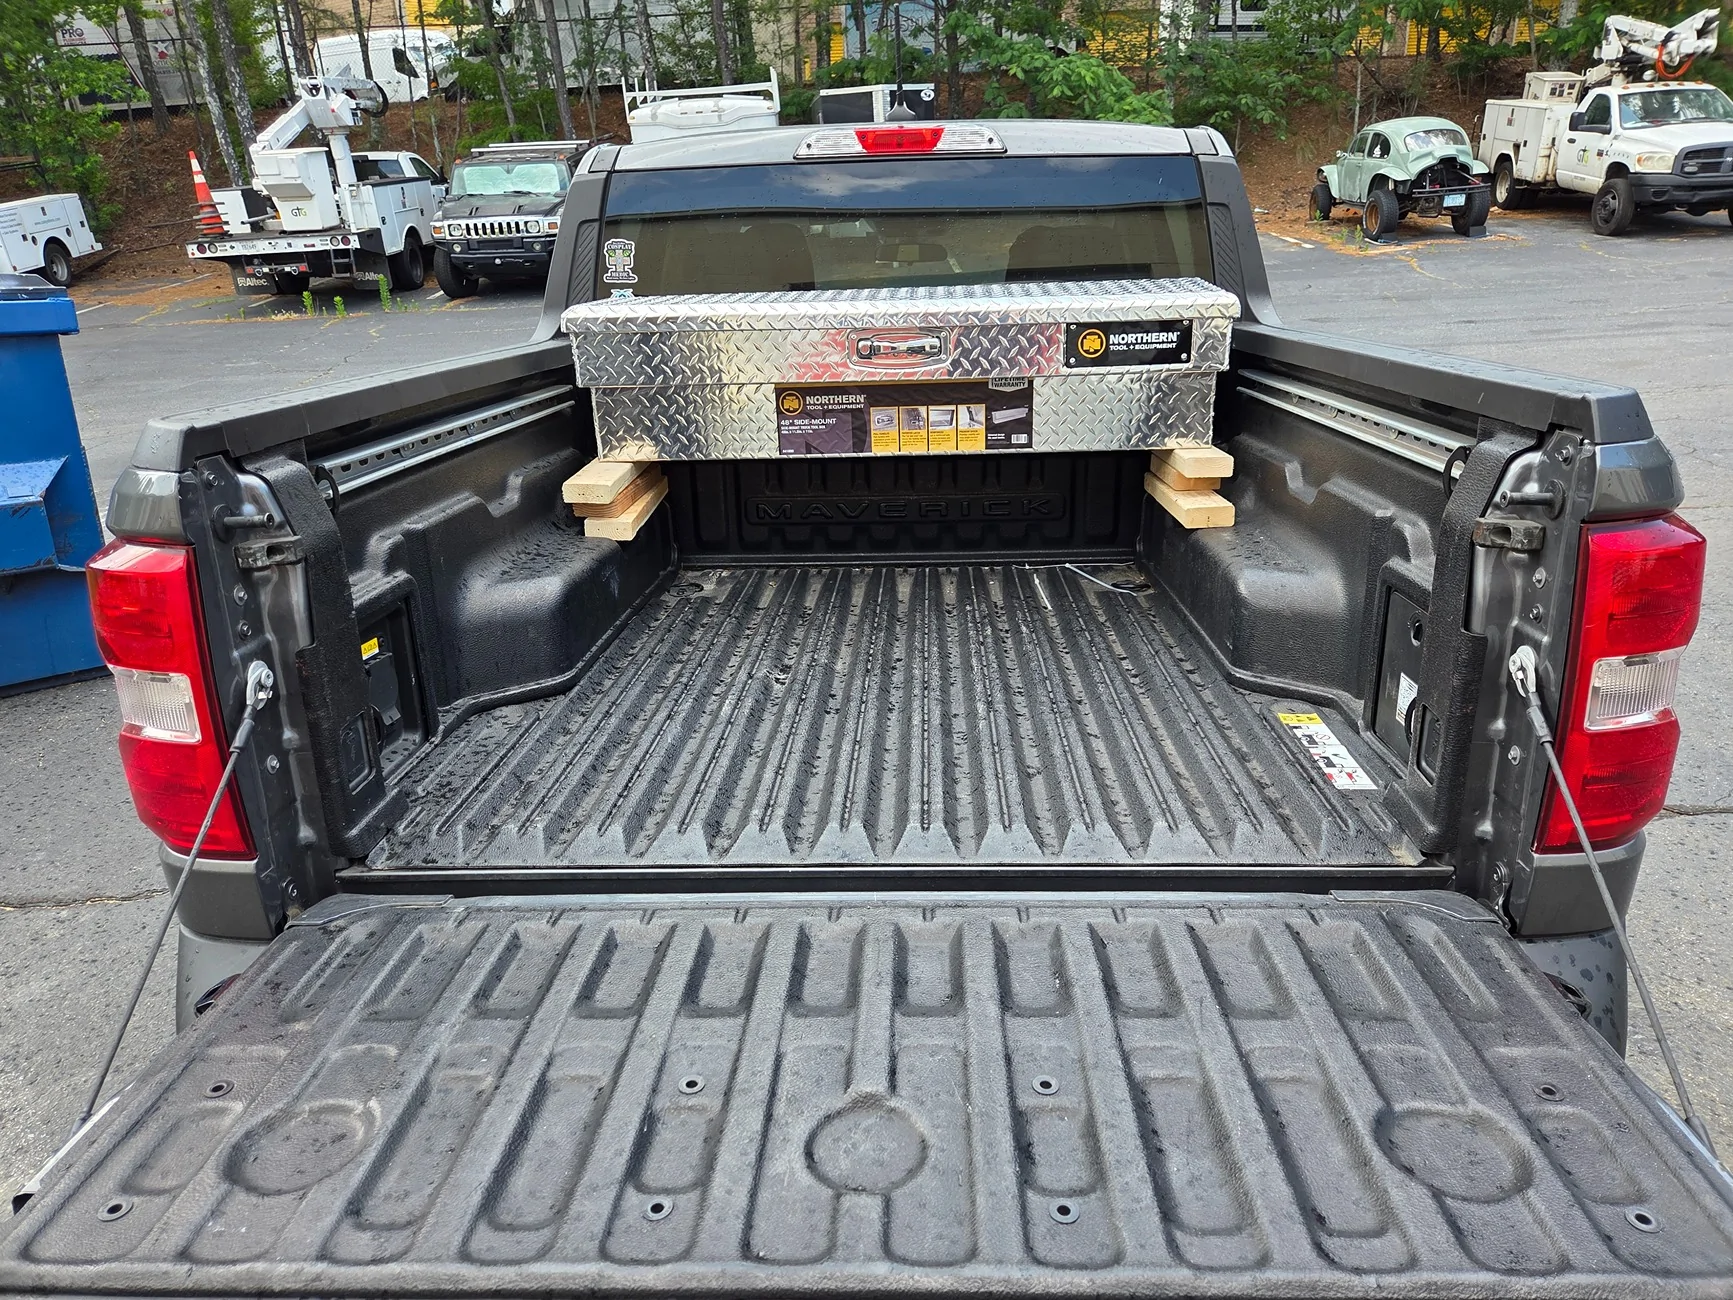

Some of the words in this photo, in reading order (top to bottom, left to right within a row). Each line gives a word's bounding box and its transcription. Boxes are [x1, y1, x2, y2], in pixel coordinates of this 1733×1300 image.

[61, 28, 84, 39] PRO
[1109, 332, 1178, 344] NORTHERN
[806, 394, 865, 404] NORTHERN
[756, 499, 1051, 520] MAVERICK
